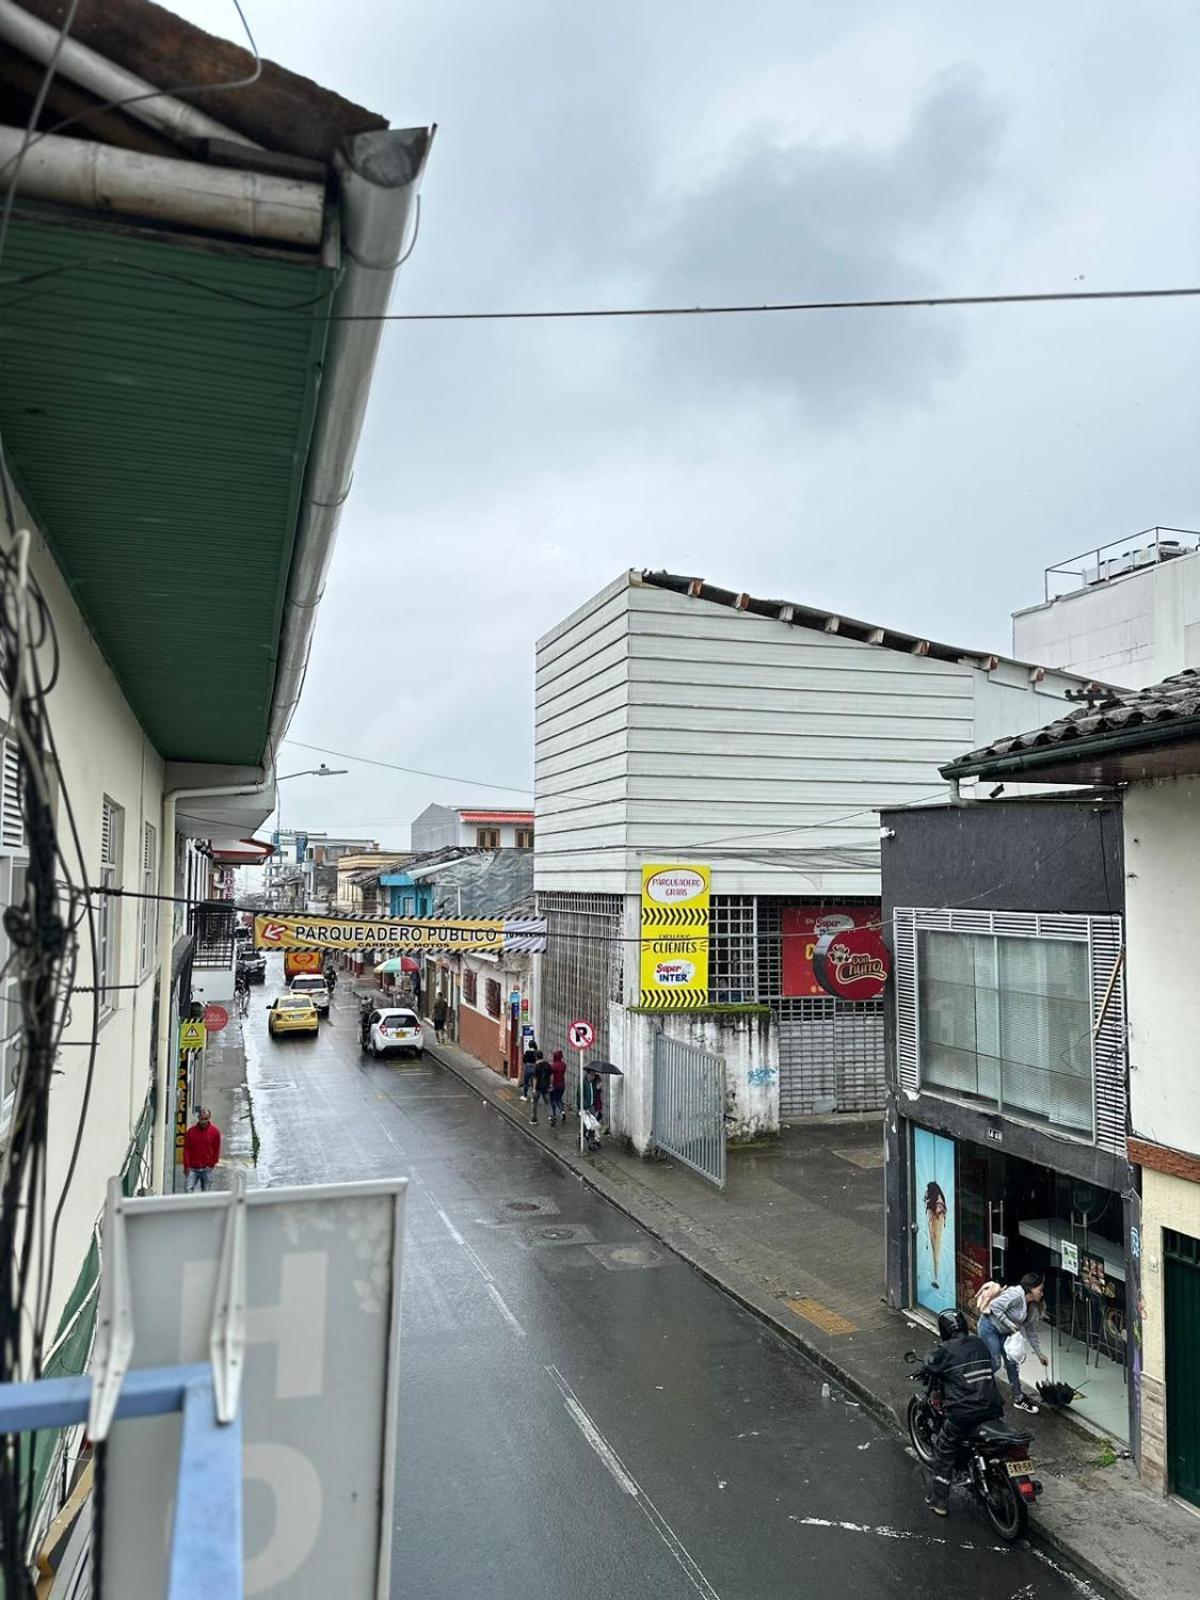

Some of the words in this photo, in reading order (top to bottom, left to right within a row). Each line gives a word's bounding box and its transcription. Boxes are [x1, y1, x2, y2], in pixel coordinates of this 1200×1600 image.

[295, 926, 422, 941] PARQUEADERO
[427, 923, 497, 941] PÚBLICO
[653, 942, 697, 953] CLIENTES
[656, 964, 682, 973] Super
[659, 974, 689, 982] INTER
